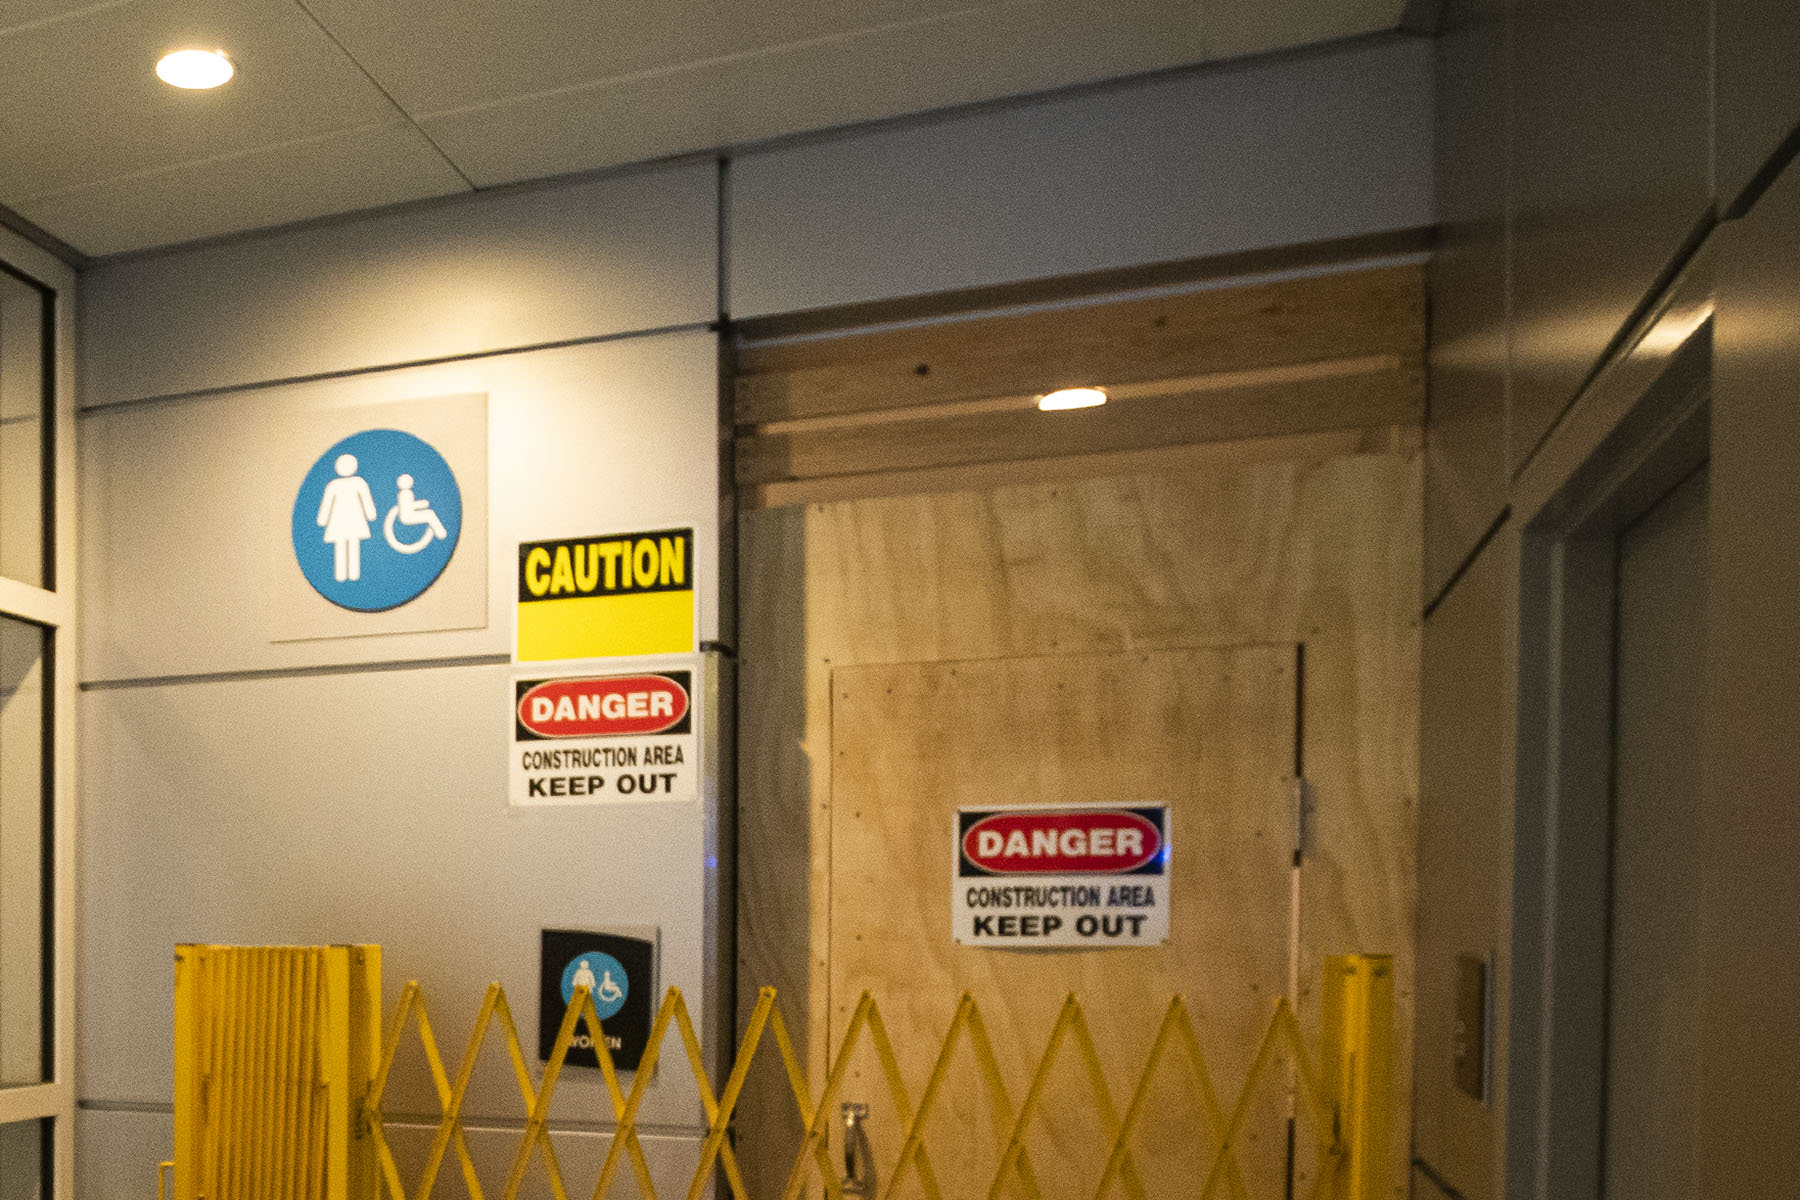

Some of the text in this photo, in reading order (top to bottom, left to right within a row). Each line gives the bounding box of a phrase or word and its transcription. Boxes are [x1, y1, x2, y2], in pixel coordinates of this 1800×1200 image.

[525, 537, 685, 597] CAUTION
[531, 691, 674, 723] DANGER
[522, 745, 684, 771] CONSTRUCTION AREA
[529, 773, 677, 797] KEEP OUT
[977, 828, 1144, 858] DANGER
[966, 886, 1155, 908] CONSTRUCTION AREA
[973, 914, 1148, 937] KEEP OUT
